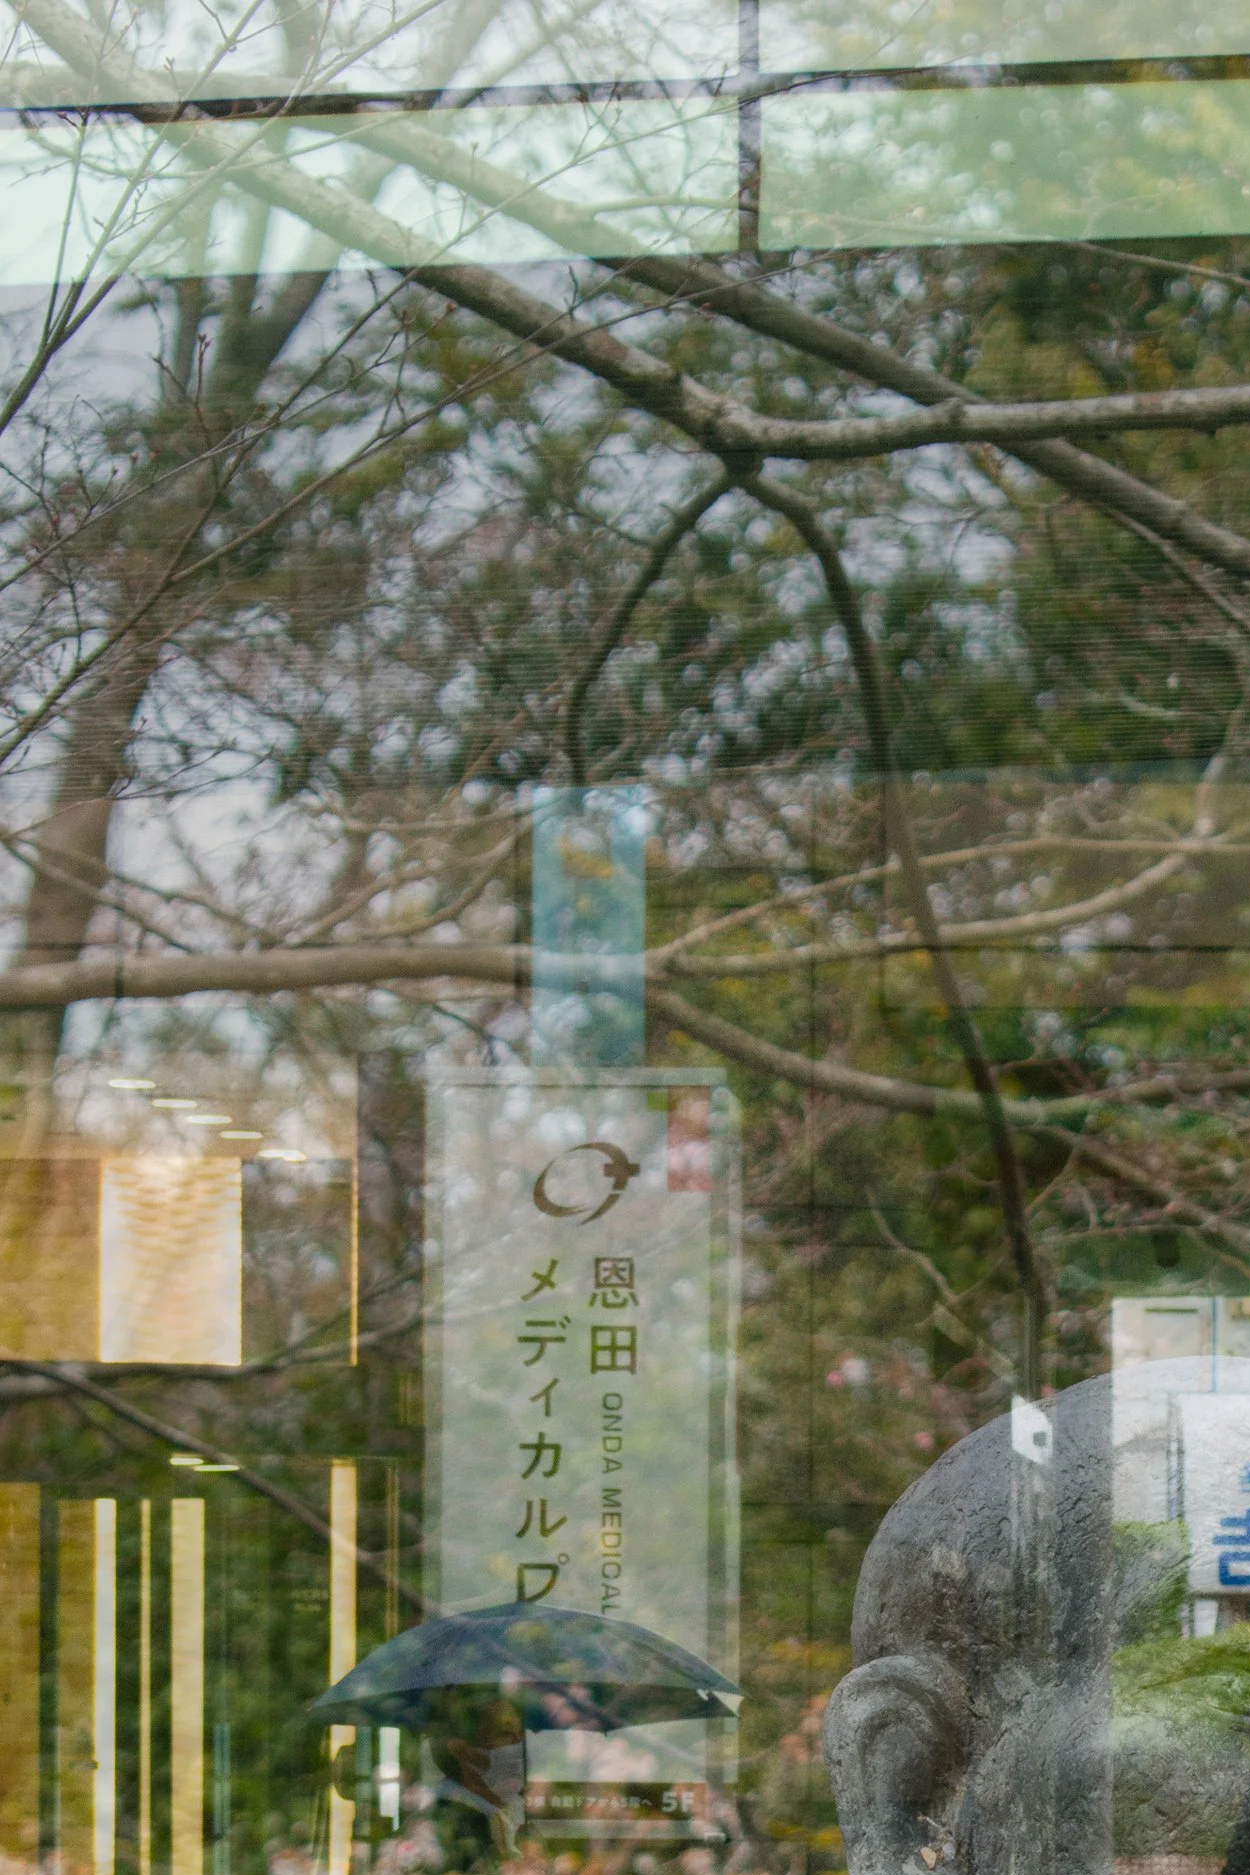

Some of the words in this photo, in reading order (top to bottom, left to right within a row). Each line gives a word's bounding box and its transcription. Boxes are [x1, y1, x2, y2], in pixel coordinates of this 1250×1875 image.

[588, 1256, 640, 1375] 恩田
[602, 1391, 624, 1475] ONDA
[601, 1487, 623, 1616] MEDICAL
[662, 1791, 695, 1813] 5F
